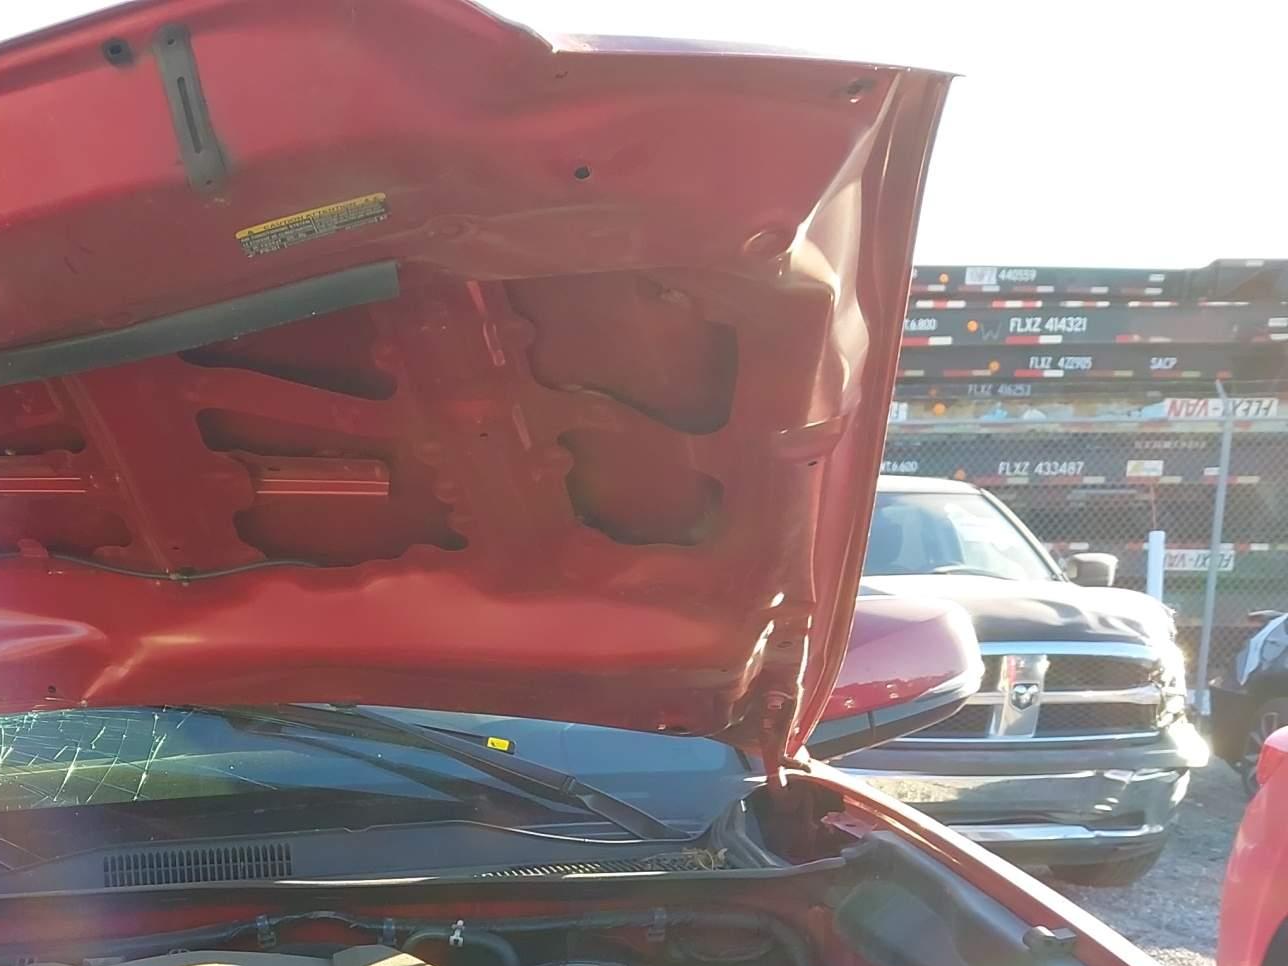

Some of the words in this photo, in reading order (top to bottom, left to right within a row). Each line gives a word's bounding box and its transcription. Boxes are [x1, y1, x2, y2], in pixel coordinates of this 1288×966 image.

[1009, 317, 1041, 332] FLXZ
[1044, 316, 1088, 332] 414321
[1029, 356, 1053, 369] FLXZ
[967, 383, 993, 395] FLXZ
[1167, 399, 1274, 417] FLEX-VAN
[998, 461, 1030, 475] FLXZ
